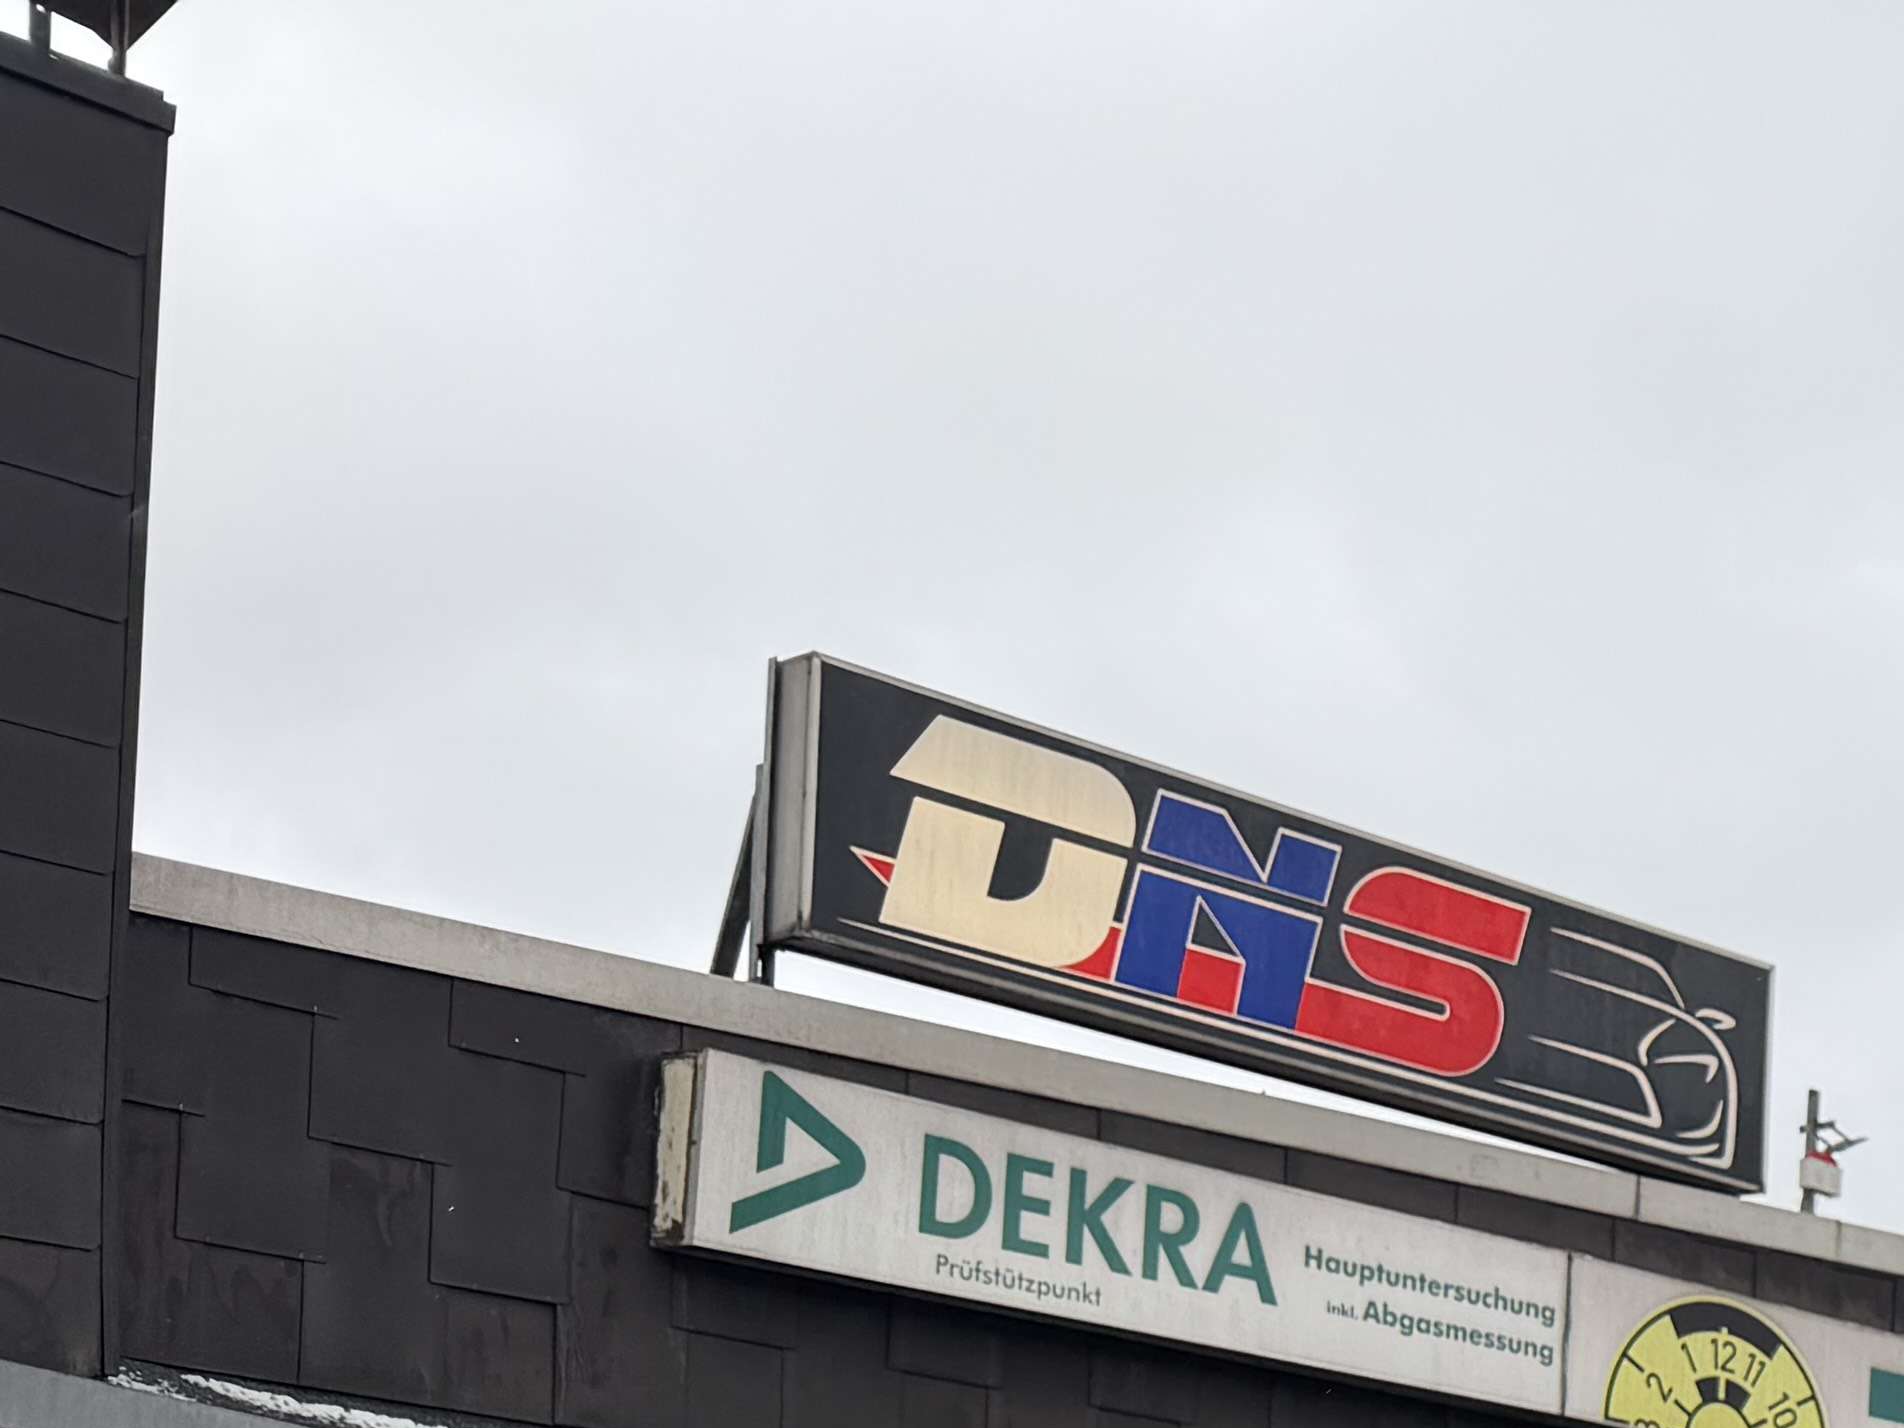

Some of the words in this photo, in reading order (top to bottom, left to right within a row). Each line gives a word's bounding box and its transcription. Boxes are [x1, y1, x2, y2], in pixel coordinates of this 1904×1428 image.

[879, 714, 1531, 1077] DNS
[918, 1132, 1279, 1307] DEKRA
[934, 1253, 1103, 1307] Prüfstützpunkt
[1303, 1244, 1557, 1328] Hauptuntersuchung
[1326, 1300, 1359, 1320] inkl.
[1362, 1300, 1555, 1367] Abgasmessung
[1710, 1337, 1738, 1375] 12
[1645, 1371, 1674, 1405] 2
[1743, 1352, 1767, 1389] 11
